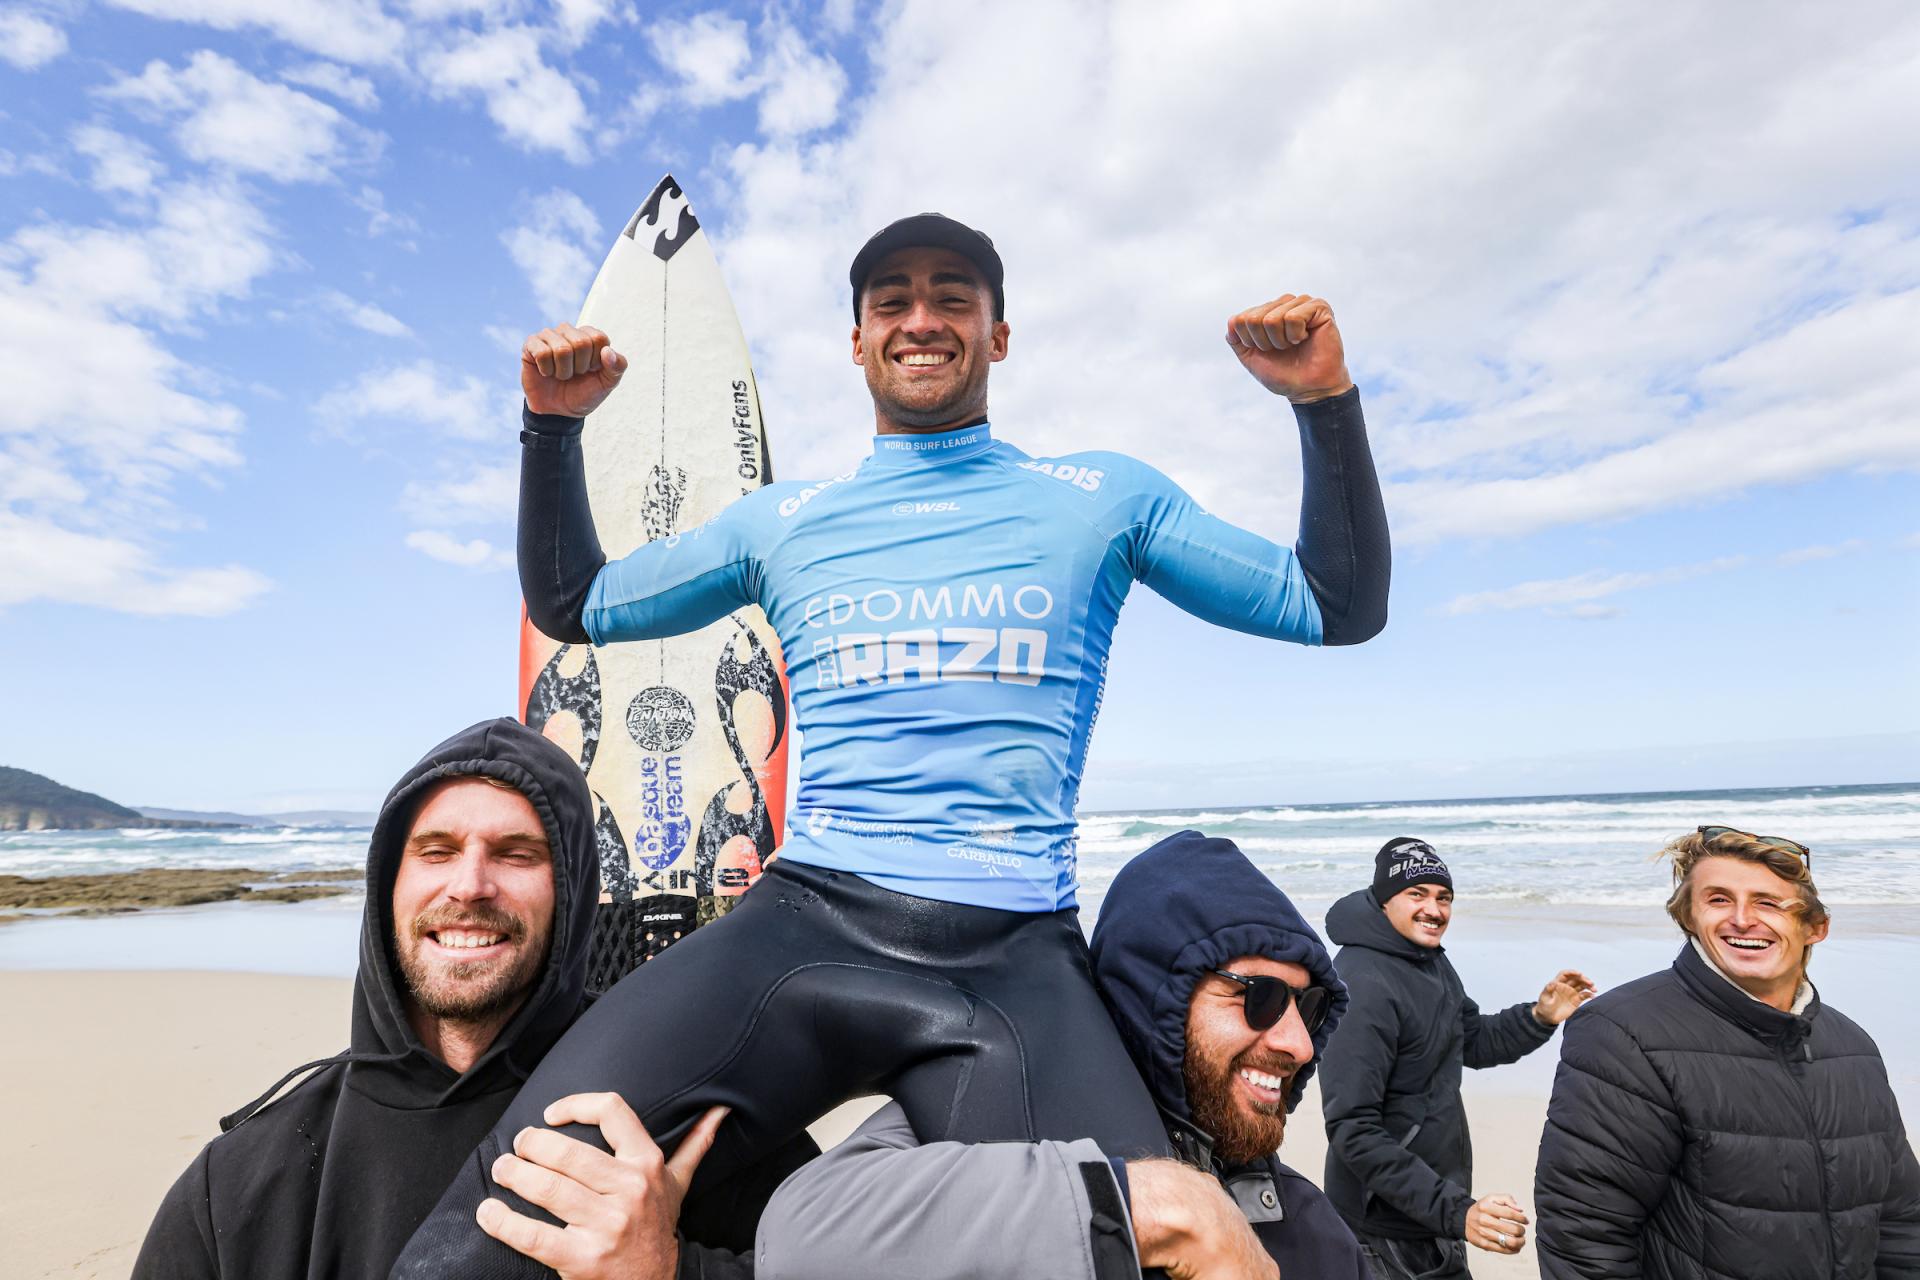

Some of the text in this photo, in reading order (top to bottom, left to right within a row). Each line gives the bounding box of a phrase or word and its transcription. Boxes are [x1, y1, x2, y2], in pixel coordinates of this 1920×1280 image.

[732, 380, 759, 480] OnlyFans
[884, 434, 978, 451] WORLD SURF LEAGUE
[915, 502, 960, 513] WSL
[837, 627, 1048, 688] RAZO
[637, 756, 662, 859] basque
[663, 755, 686, 824] team
[946, 847, 1023, 869] CARBALLO
[642, 913, 683, 922] DAKINE
